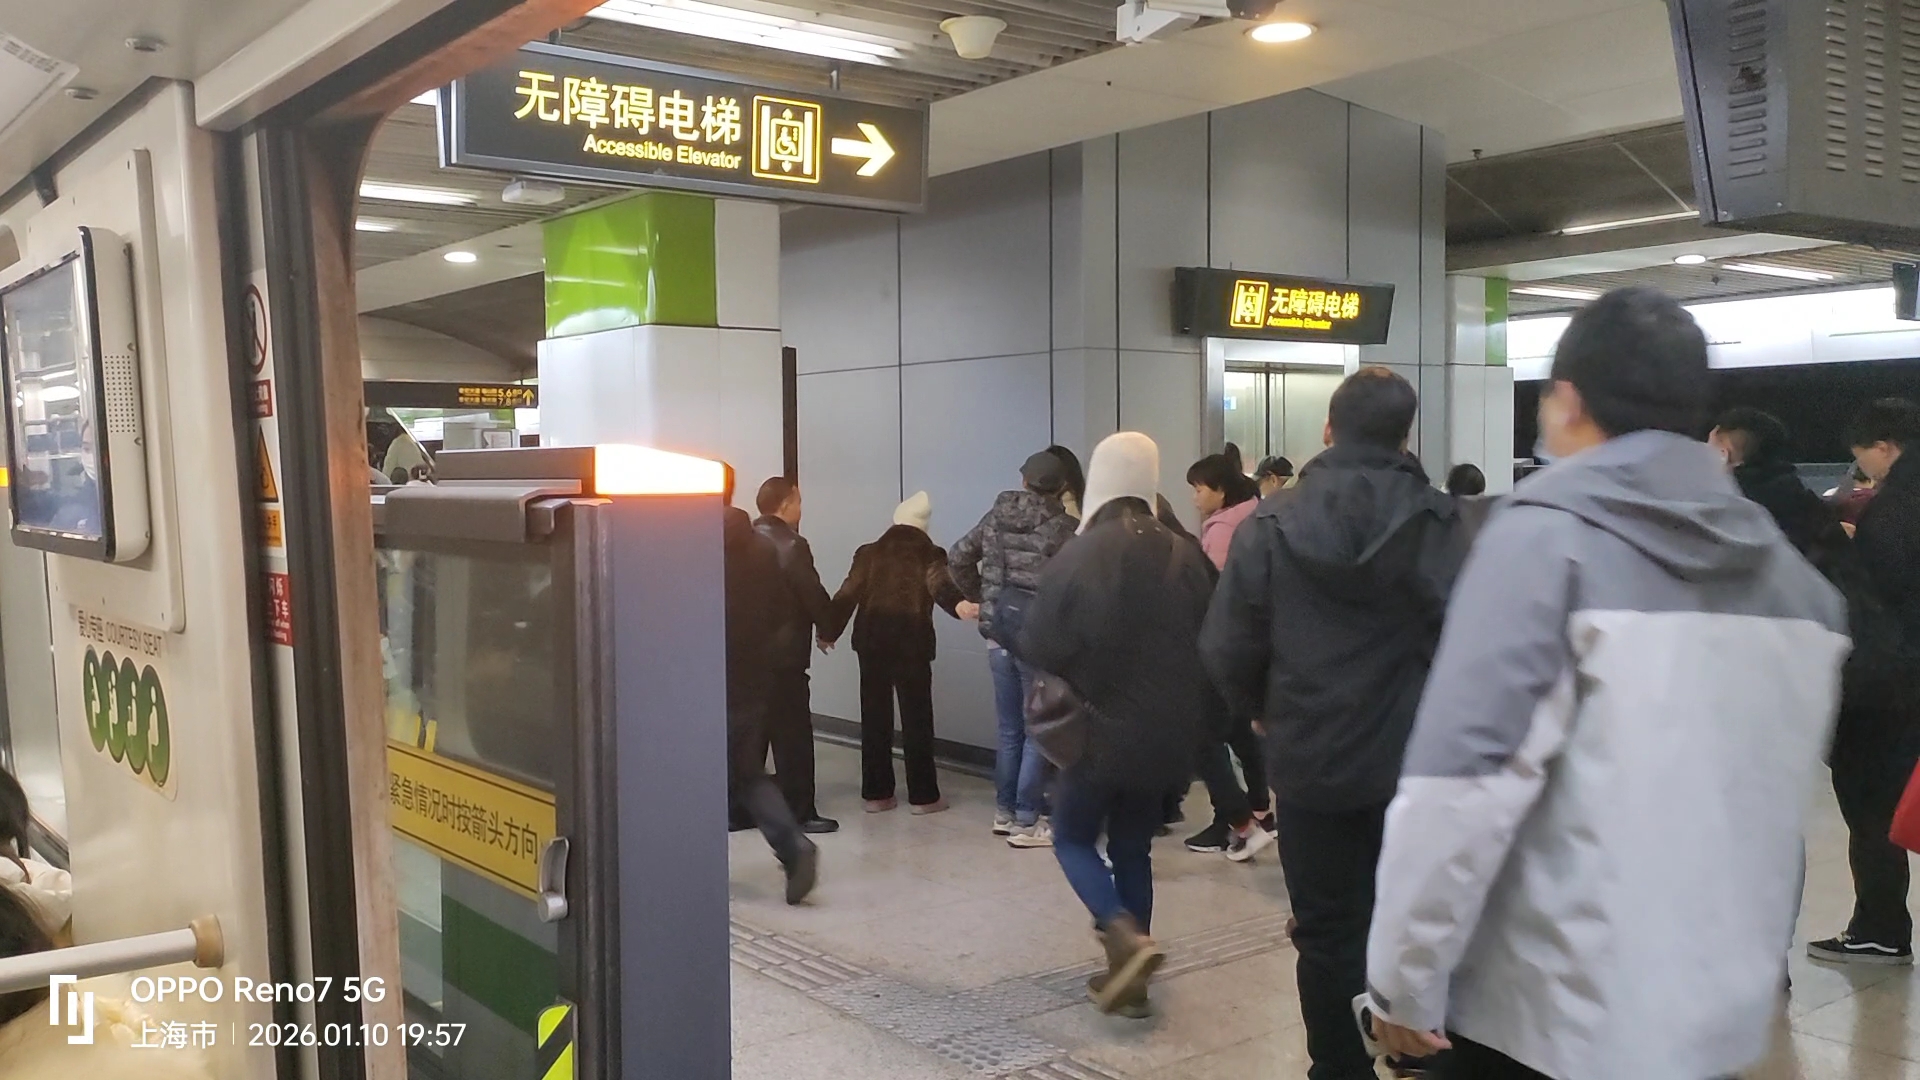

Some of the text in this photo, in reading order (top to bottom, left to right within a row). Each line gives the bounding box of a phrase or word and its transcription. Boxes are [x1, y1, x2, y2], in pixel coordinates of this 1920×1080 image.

[514, 70, 741, 145] 无障碍电梯
[583, 134, 742, 169] Accessible Elevator
[1269, 288, 1360, 319] 无障碍电梯
[390, 772, 538, 865] 紧急情况时按箭头方向
